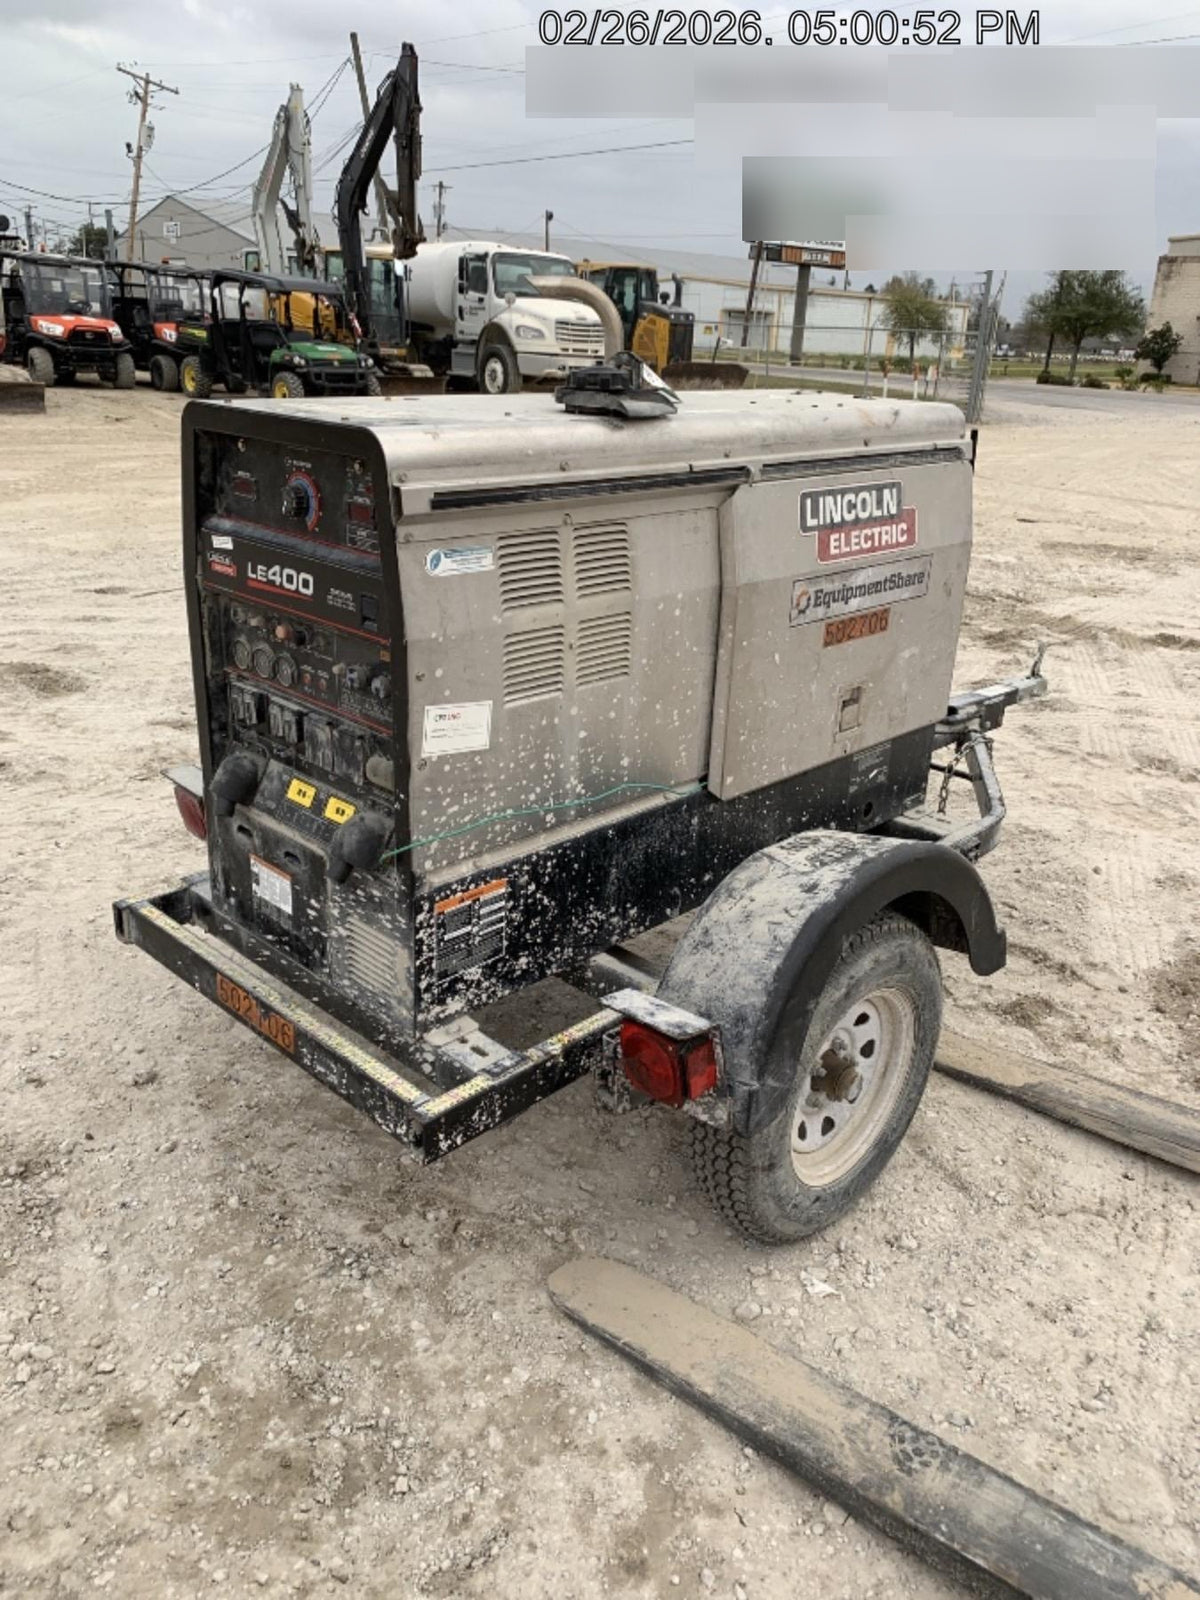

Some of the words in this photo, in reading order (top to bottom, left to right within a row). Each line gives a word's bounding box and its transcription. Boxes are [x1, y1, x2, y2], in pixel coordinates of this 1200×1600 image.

[804, 487, 898, 528] LINCOLN
[828, 522, 909, 556] ELECTRIC
[247, 561, 314, 597] LE400
[812, 569, 926, 609] EquipmentShare
[219, 977, 293, 1049] 50206
